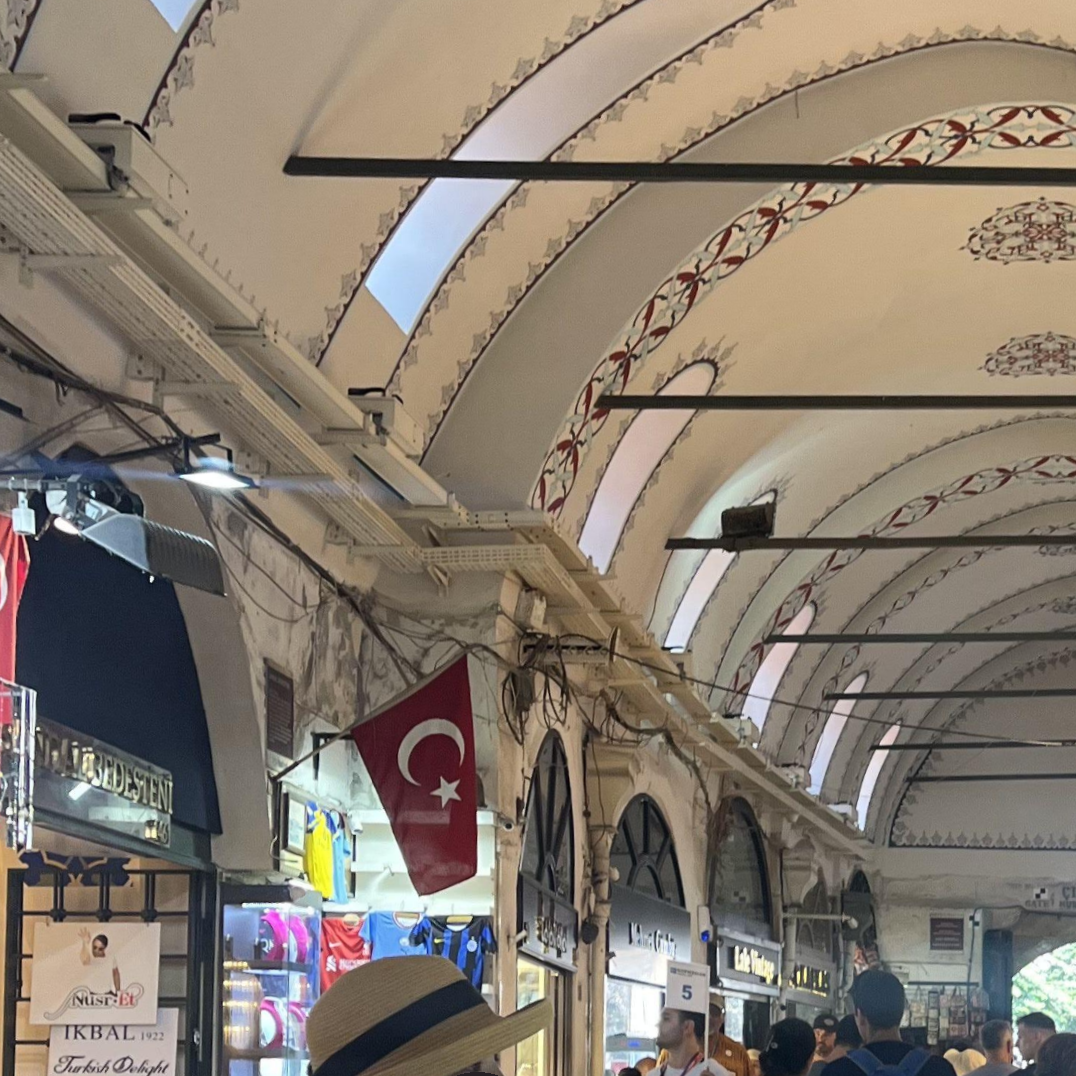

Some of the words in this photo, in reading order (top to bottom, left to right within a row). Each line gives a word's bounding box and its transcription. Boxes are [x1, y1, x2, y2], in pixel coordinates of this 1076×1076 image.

[681, 984, 693, 1001] 5
[141, 1031, 165, 1041] 1922
[53, 1055, 111, 1074] Turkish
